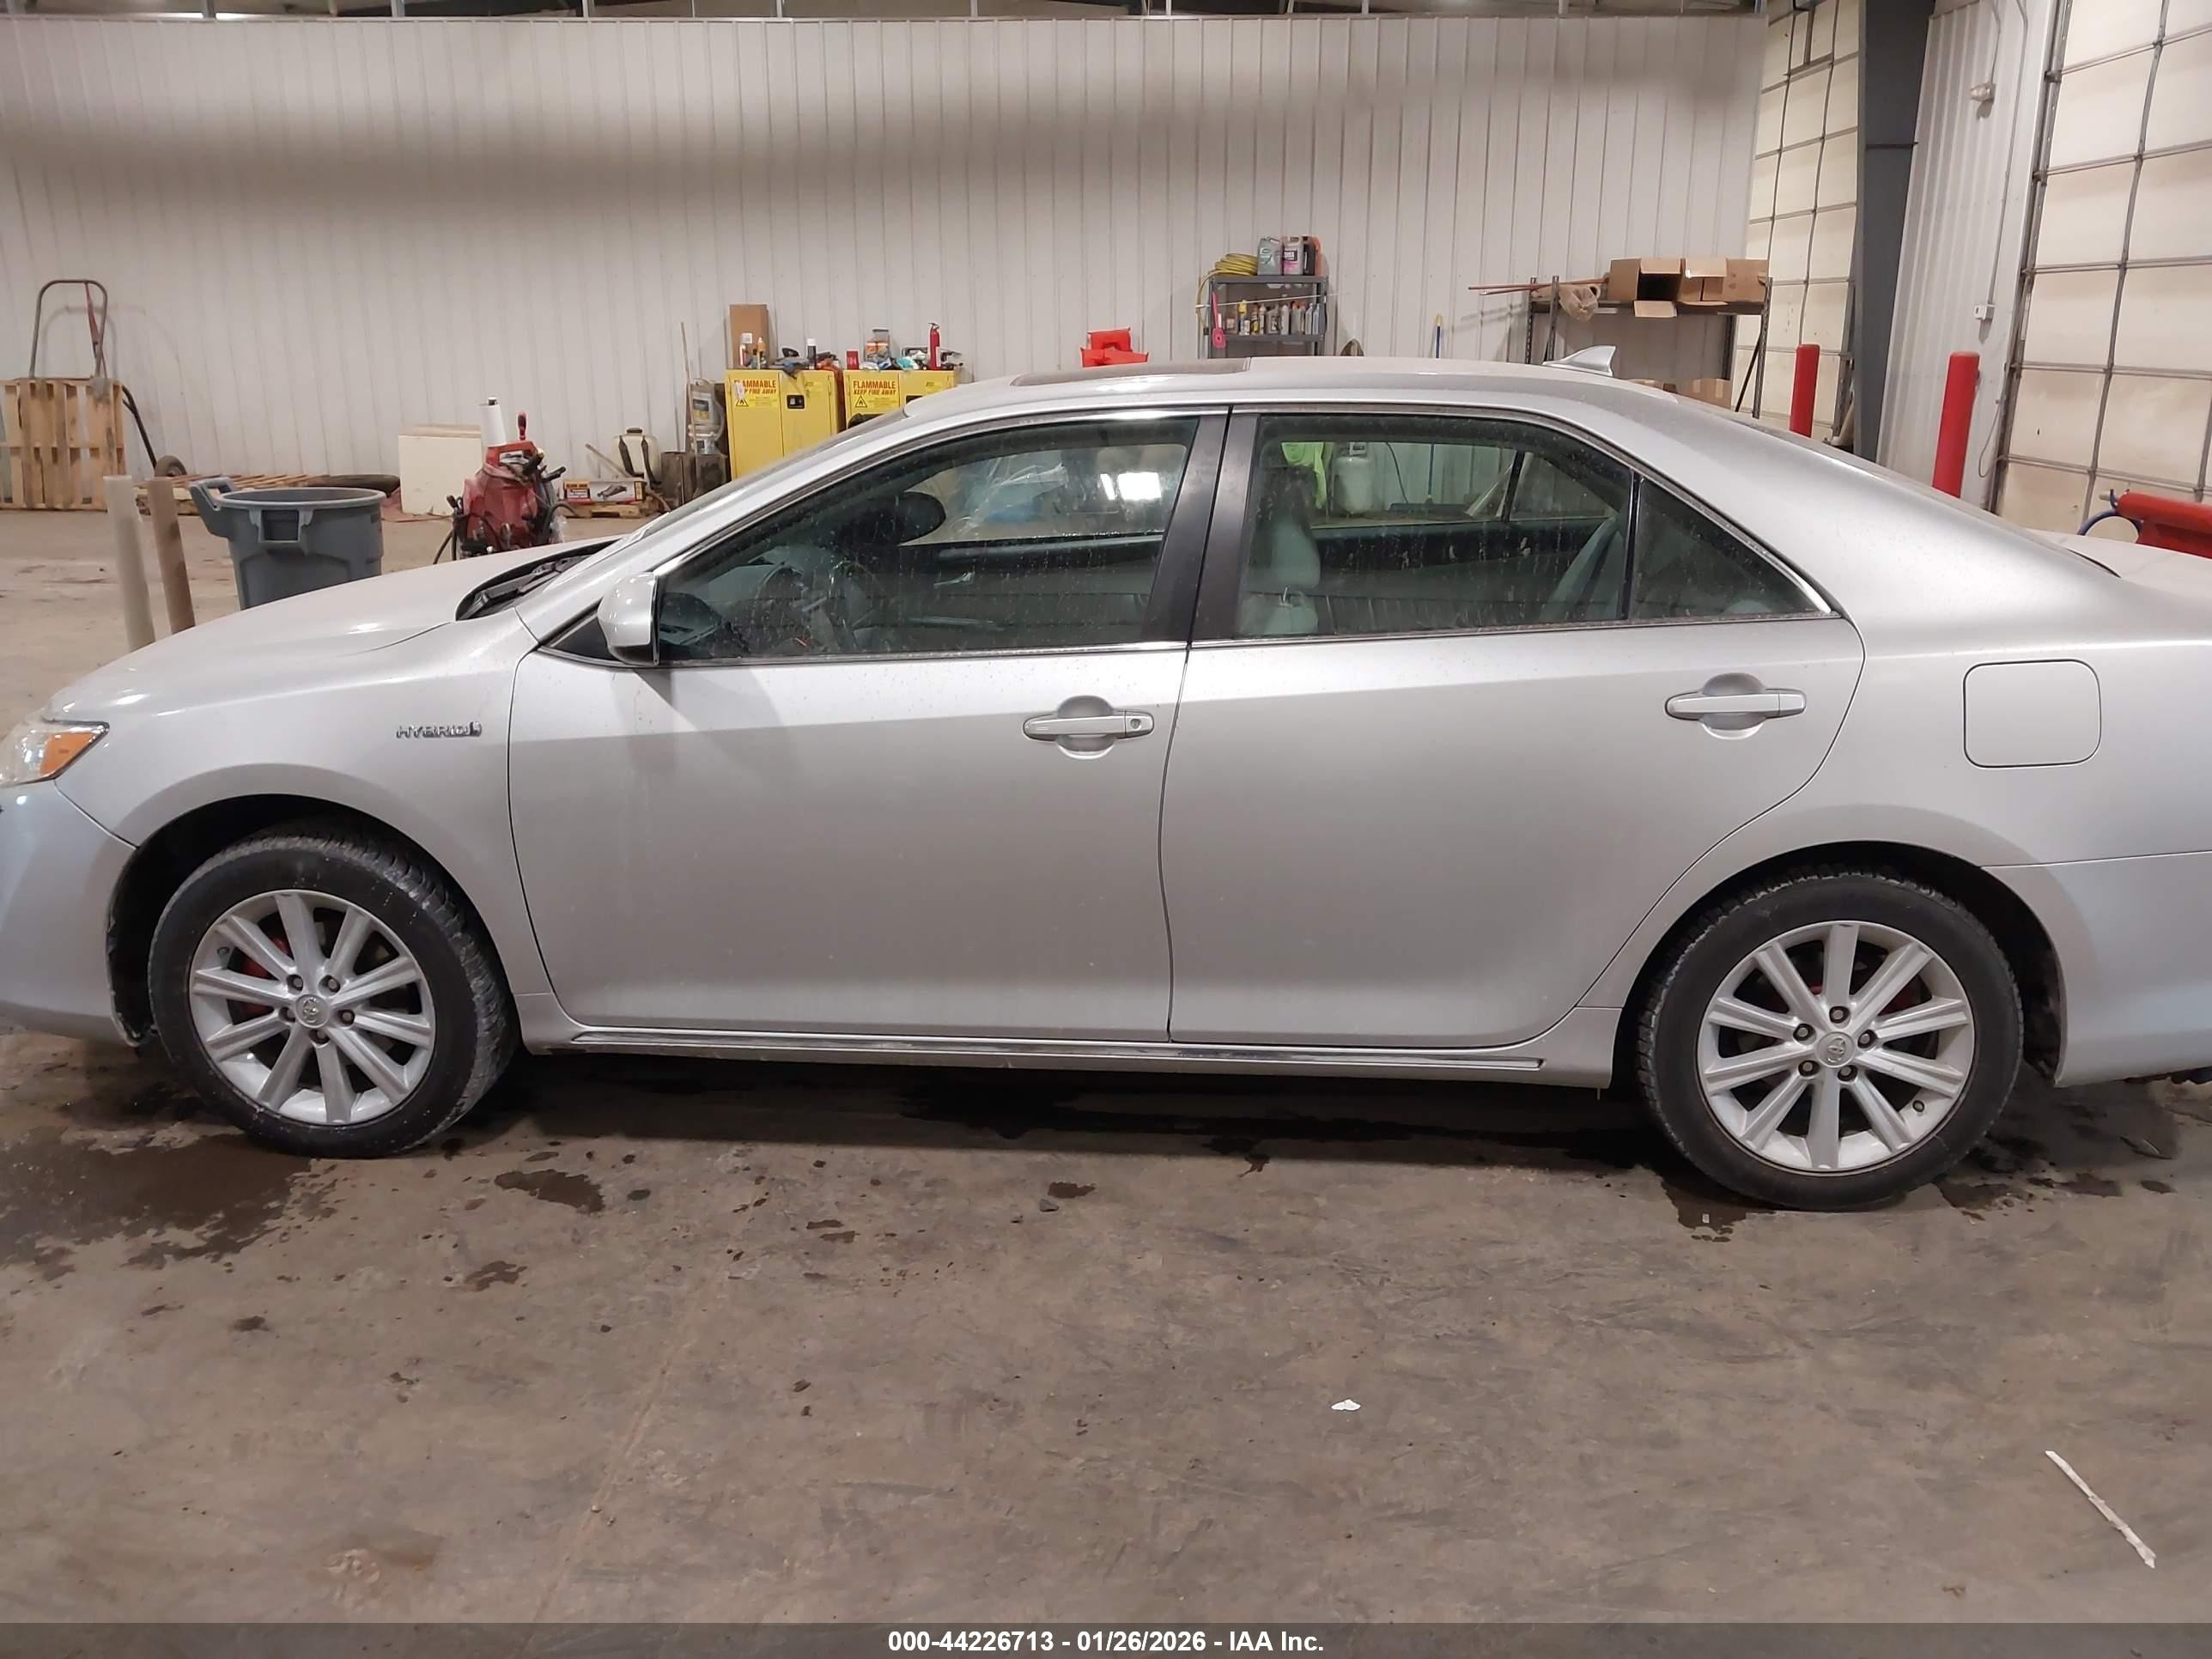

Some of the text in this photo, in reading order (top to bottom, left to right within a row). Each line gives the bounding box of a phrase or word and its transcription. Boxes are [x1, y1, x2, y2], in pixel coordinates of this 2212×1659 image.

[734, 380, 776, 389] AMMABLE
[853, 380, 896, 390] FLAMMABLE
[396, 726, 468, 738] HYBRID
